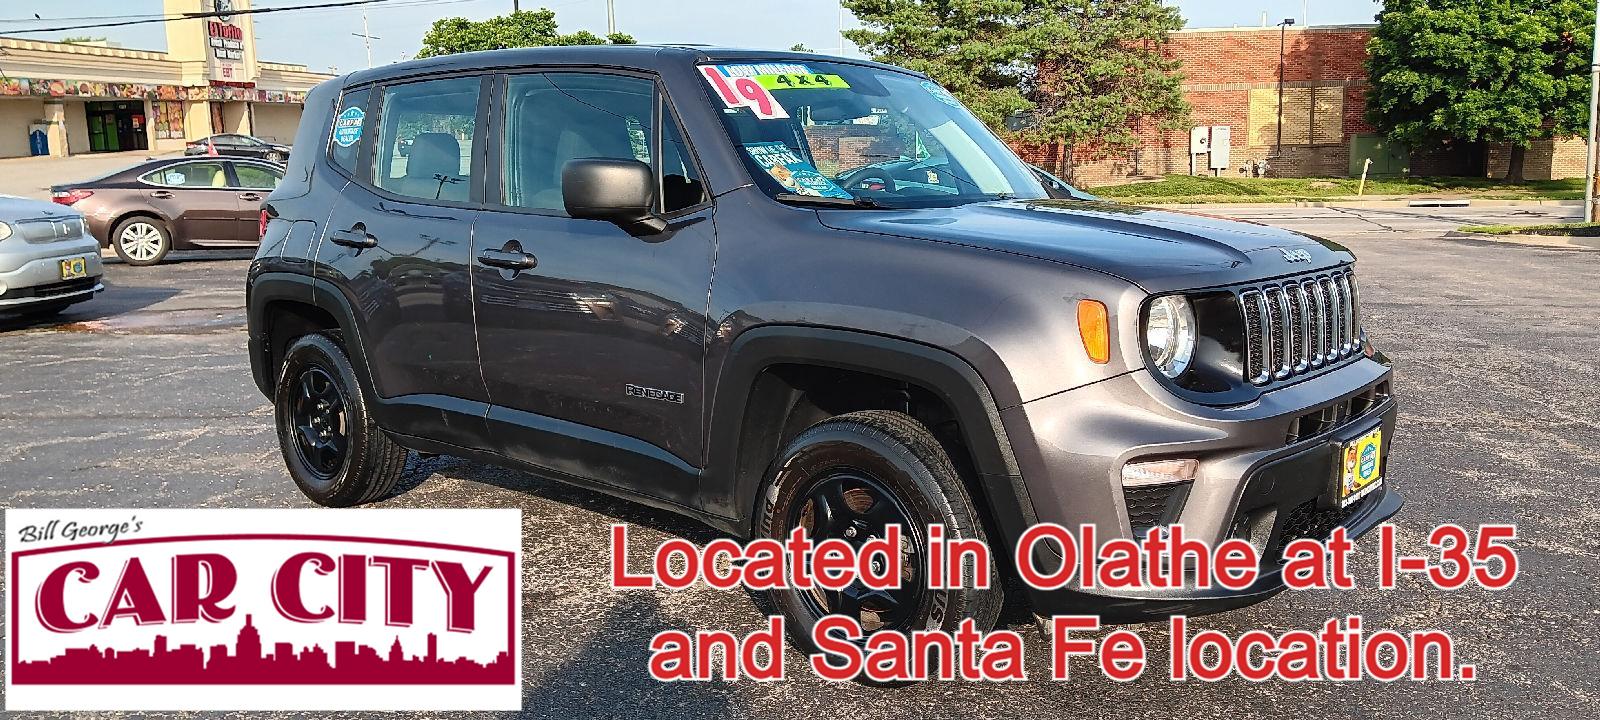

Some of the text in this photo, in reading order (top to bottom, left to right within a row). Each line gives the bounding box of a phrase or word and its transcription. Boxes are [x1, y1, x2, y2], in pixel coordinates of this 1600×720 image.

[703, 66, 773, 116] 19
[754, 152, 803, 167] CARFAX
[1279, 247, 1312, 264] Jeep
[625, 383, 685, 404] RENEGADE
